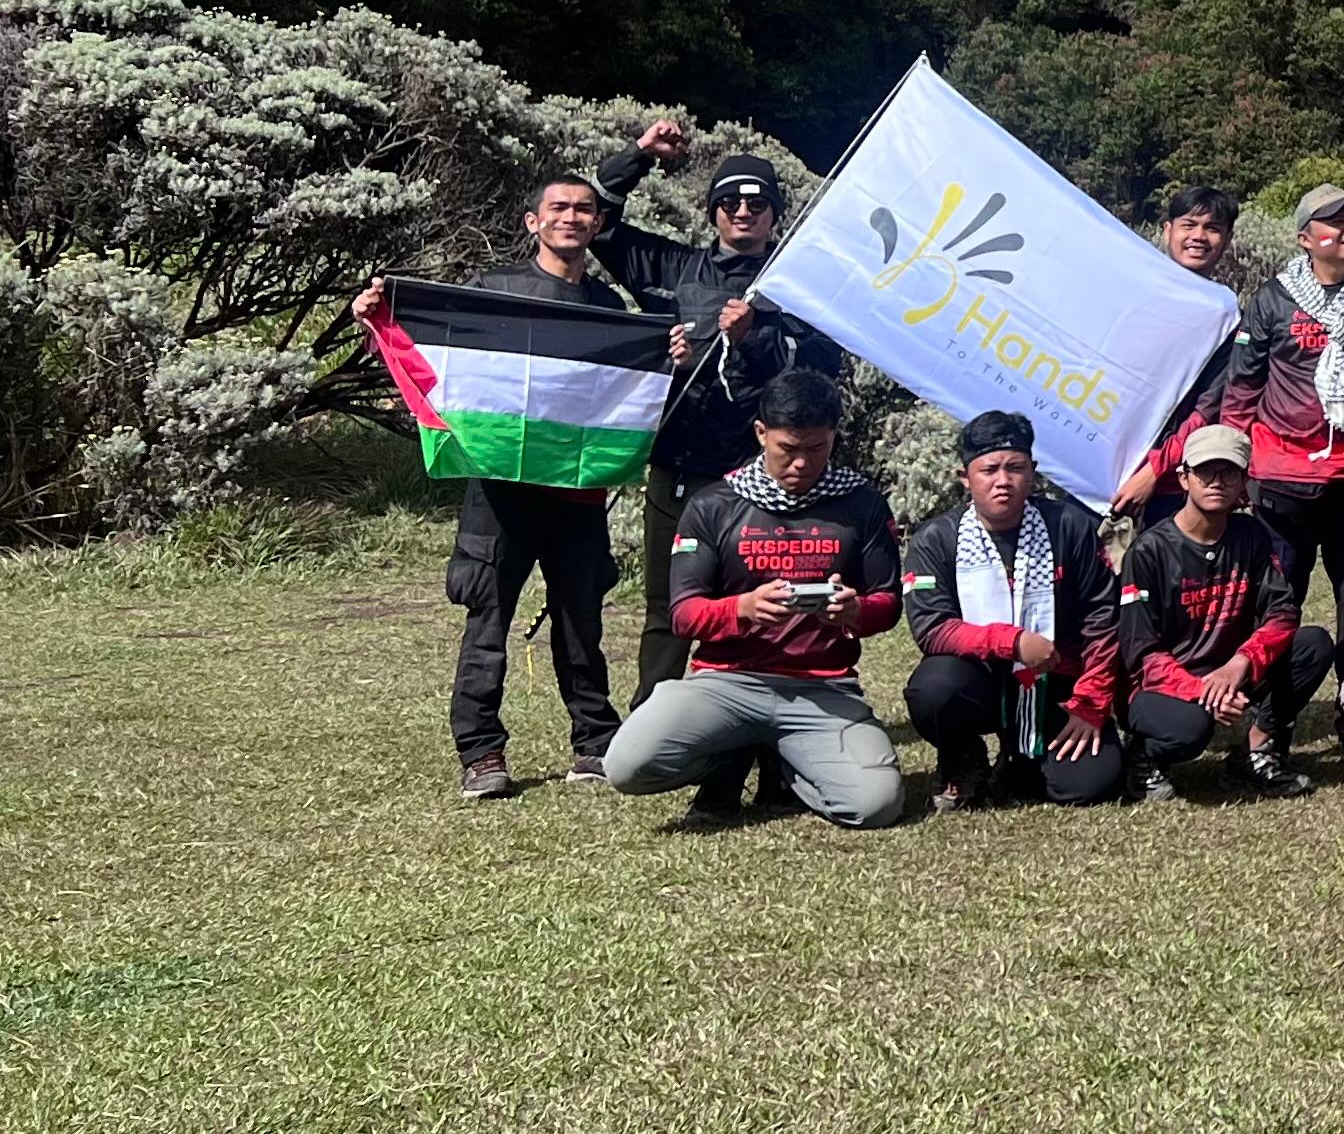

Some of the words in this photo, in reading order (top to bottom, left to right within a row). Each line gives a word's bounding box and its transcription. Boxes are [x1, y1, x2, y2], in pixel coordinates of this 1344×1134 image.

[956, 294, 1120, 423] Hands
[946, 339, 967, 360] To
[982, 362, 1018, 394] The
[1033, 396, 1098, 442] World
[738, 539, 840, 555] EKSPEDISI
[743, 556, 795, 571] 1000
